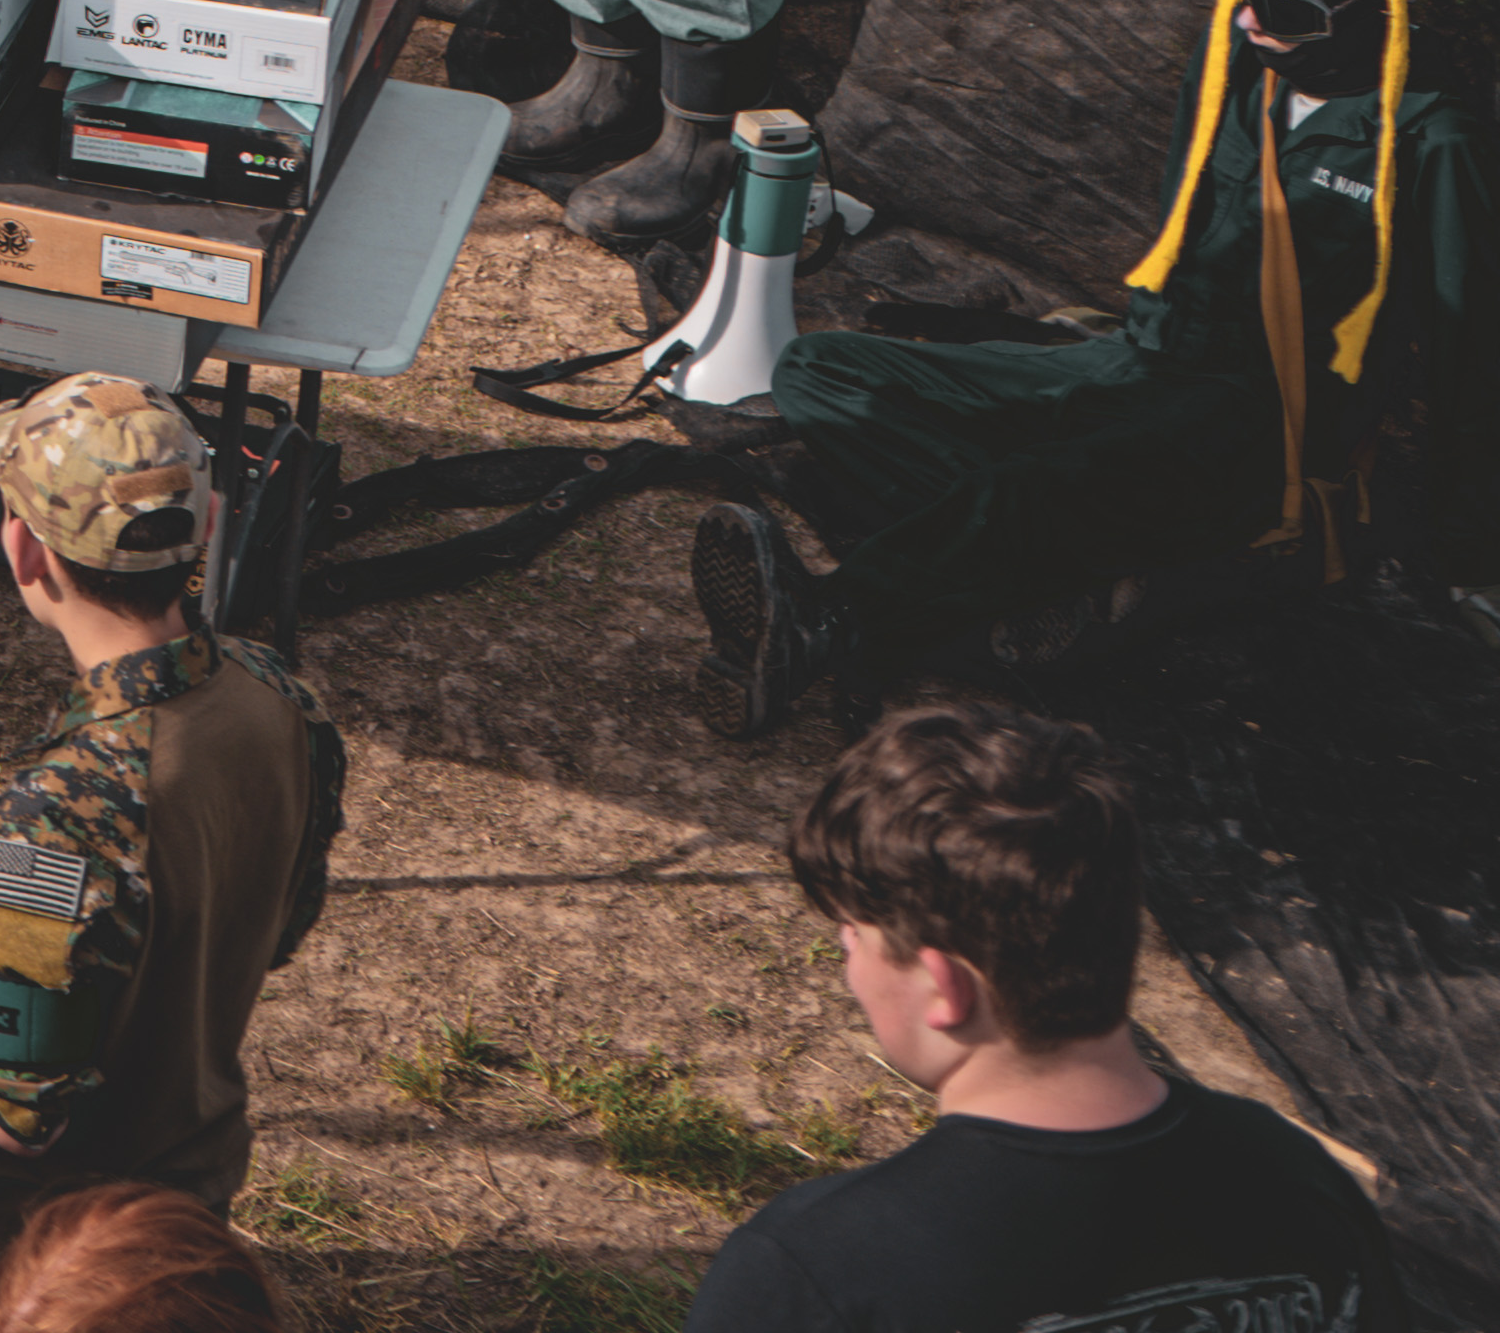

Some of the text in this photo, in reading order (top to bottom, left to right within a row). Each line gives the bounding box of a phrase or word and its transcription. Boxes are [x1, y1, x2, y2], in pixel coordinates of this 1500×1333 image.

[77, 27, 115, 40] EMG
[182, 28, 227, 49] CYMA
[121, 36, 168, 51] LANTAC
[180, 46, 227, 60] PLATINUM
[1332, 175, 1374, 203] NAVY
[118, 240, 166, 255] KRYTAC
